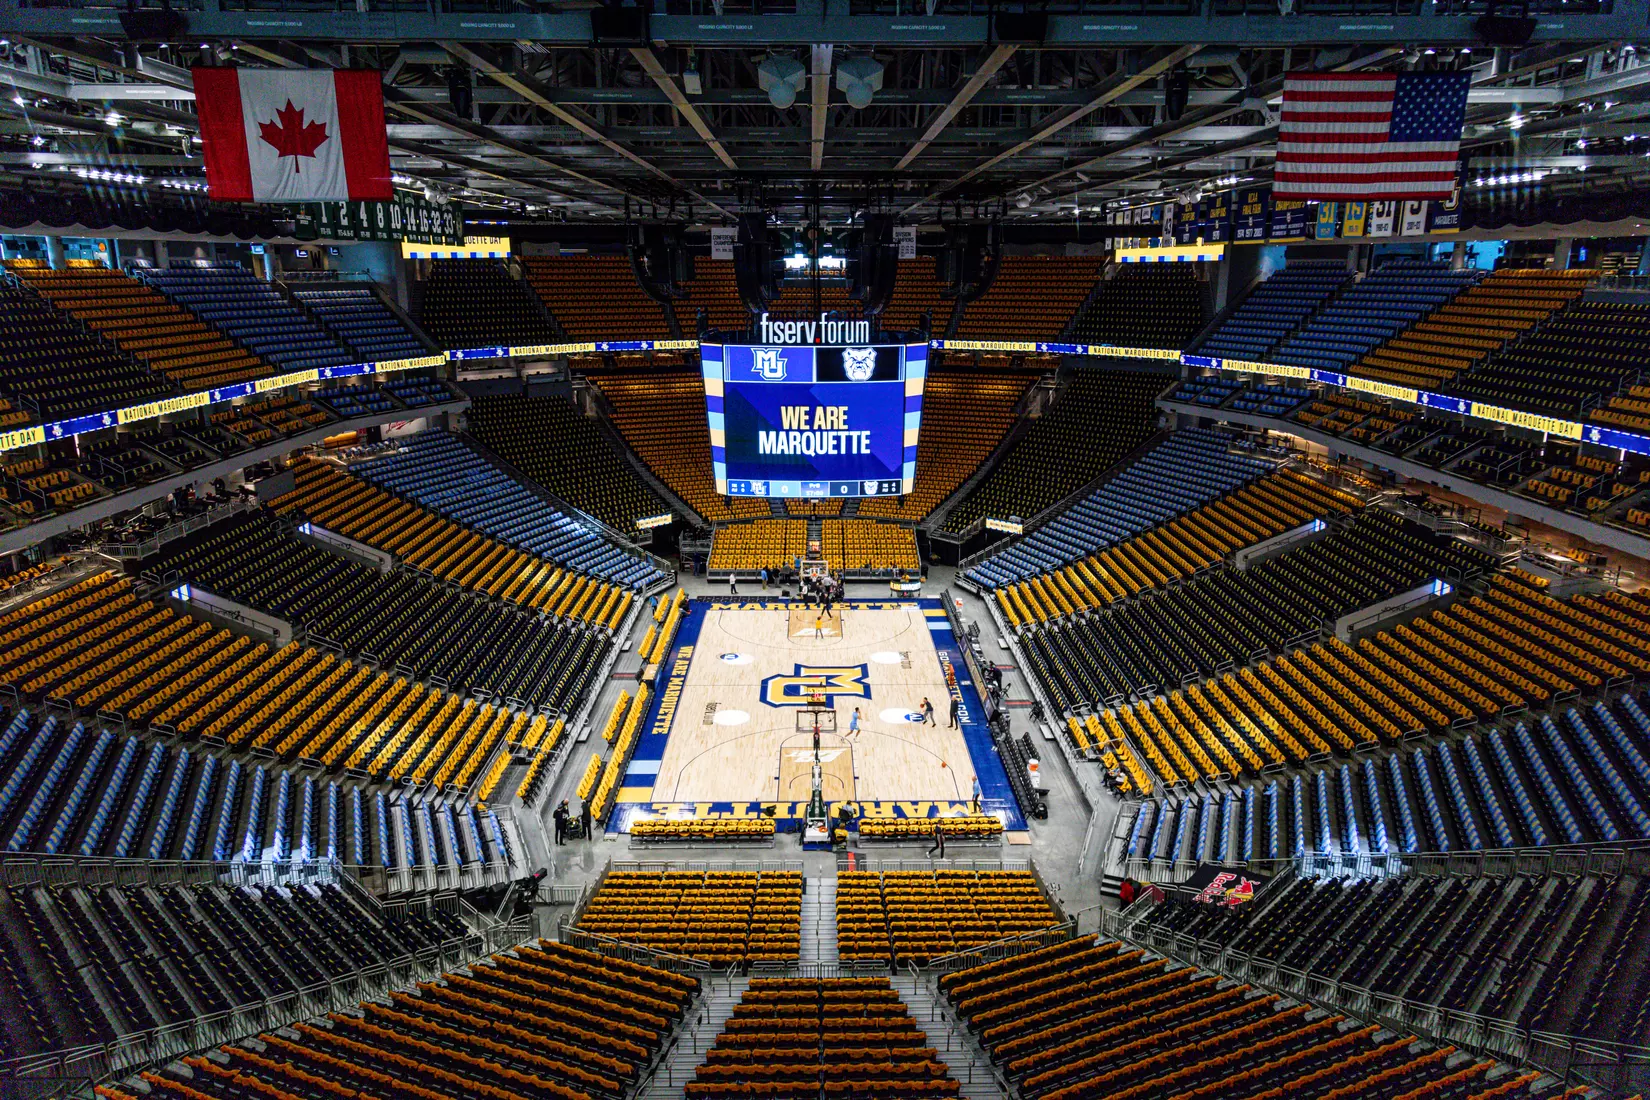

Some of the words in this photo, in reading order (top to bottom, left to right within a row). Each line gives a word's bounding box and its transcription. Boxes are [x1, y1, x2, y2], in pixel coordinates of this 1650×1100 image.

[339, 201, 348, 225] 2
[360, 201, 368, 227] 4
[377, 202, 384, 228] 8
[390, 204, 401, 229] 10
[406, 207, 416, 231] 14
[419, 208, 428, 232] 16
[431, 210, 442, 233] 32
[444, 212, 453, 234] 33
[1435, 214, 1458, 225] MARQUETTE
[514, 347, 542, 355] NATIONAL
[545, 345, 577, 354] MARQUETTE
[1093, 347, 1121, 355] NATIONAL
[1124, 348, 1159, 358] MARQUETTE
[380, 361, 407, 370] NATIONAL
[409, 357, 439, 367] MARQUETTE
[751, 348, 788, 380] MU
[1227, 361, 1253, 371] NATIONAL
[1256, 364, 1290, 375] MARQUETTE
[1293, 368, 1304, 377] DAY
[1350, 378, 1371, 390] NATIONAL
[1373, 384, 1402, 396] MARQUETTE
[1402, 389, 1413, 398] DAY
[123, 404, 155, 421] NATIONAL
[158, 398, 192, 412] MARQUETTE
[194, 395, 205, 404] DAY
[780, 406, 809, 430] WE
[813, 406, 848, 430] ARE
[1477, 405, 1508, 421] NATIONAL
[1512, 413, 1556, 432] MARQUETTE
[1559, 423, 1575, 435] DAY
[19, 430, 36, 444] DAY
[759, 431, 870, 456] MARQUETTE
[781, 485, 788, 493] 0
[841, 485, 848, 494] 0
[677, 646, 694, 658] WE
[671, 660, 690, 676] ARE
[651, 677, 684, 734] MARQUETTE
